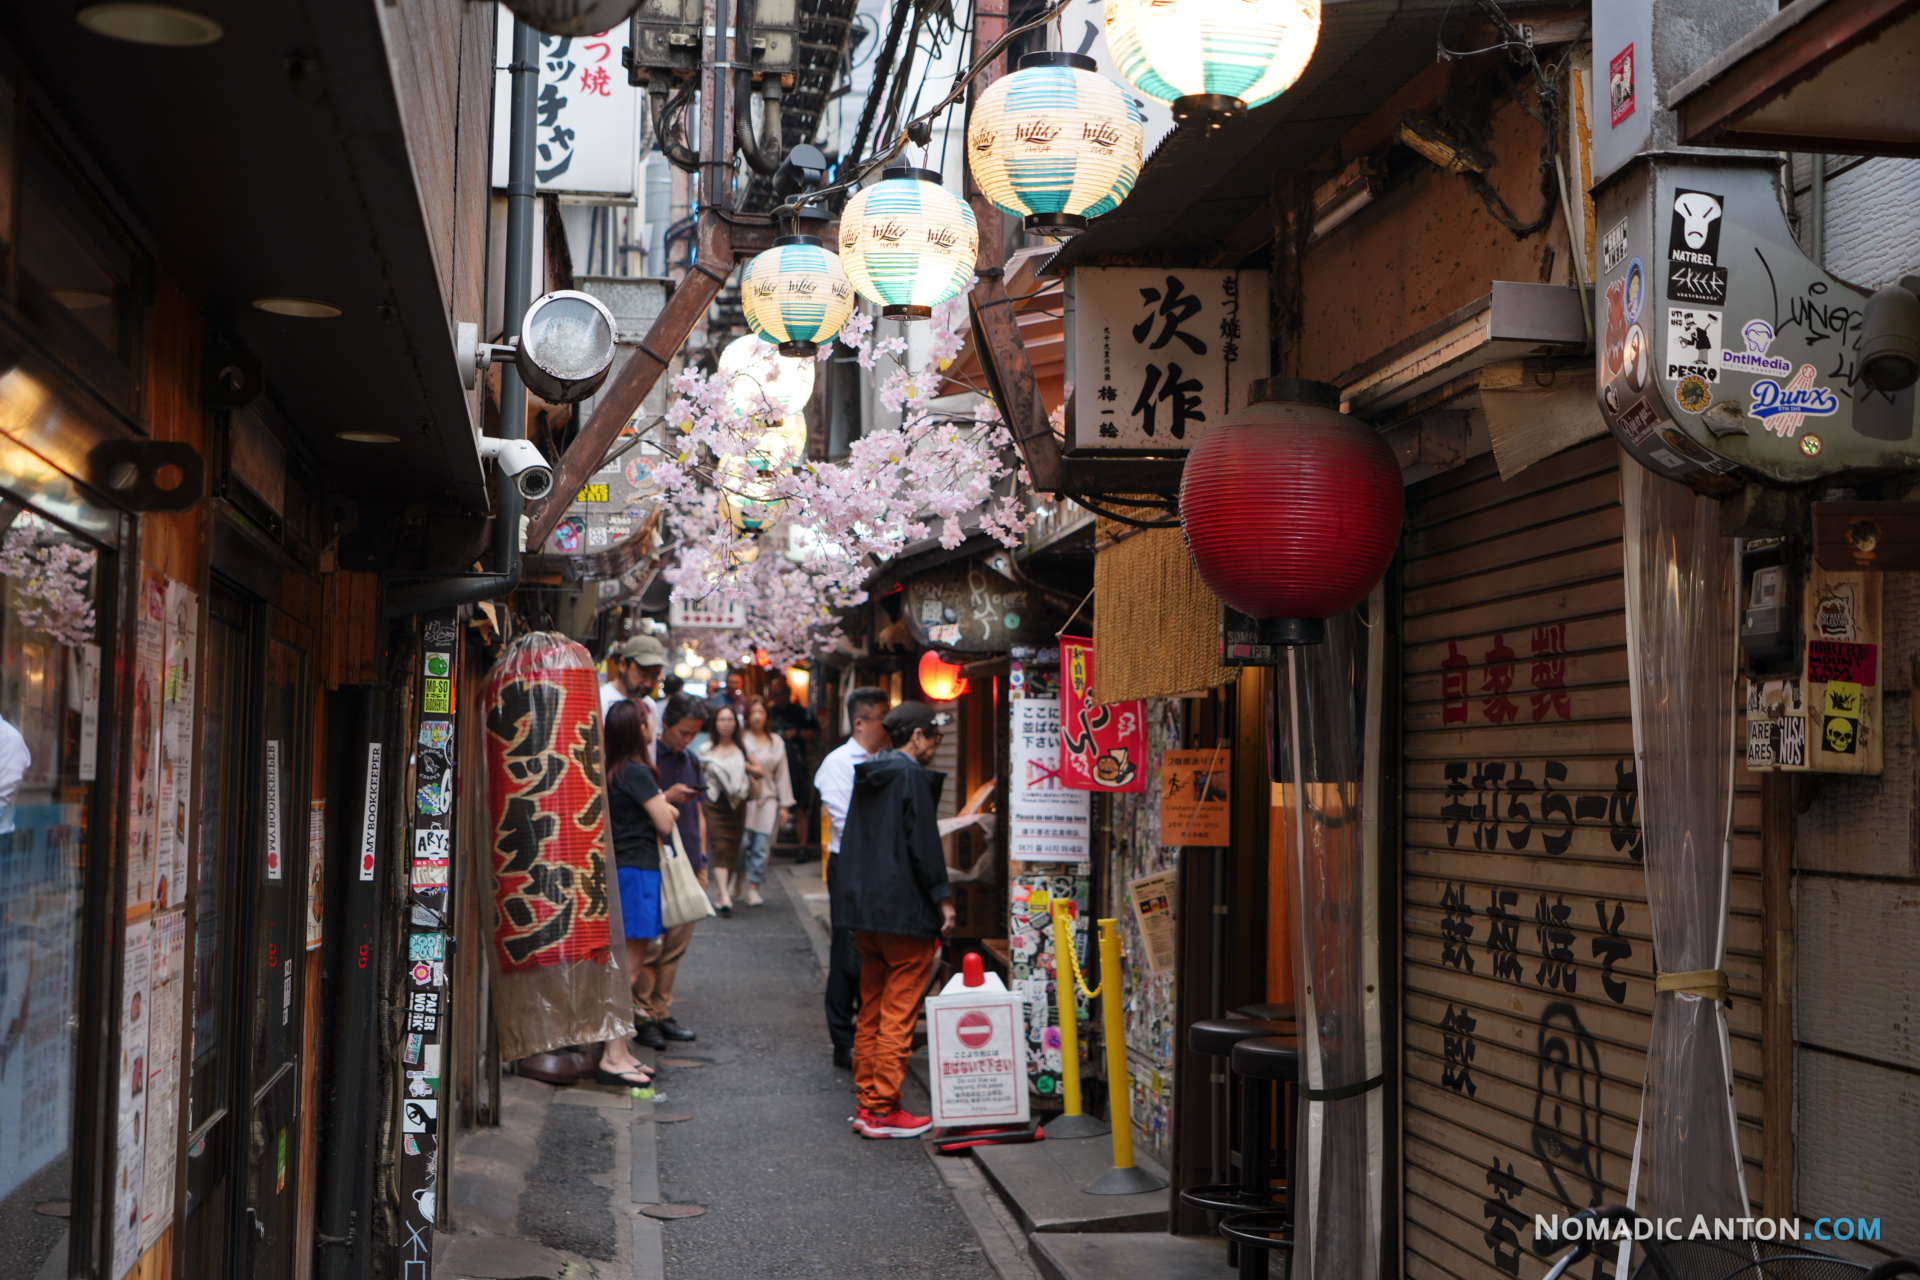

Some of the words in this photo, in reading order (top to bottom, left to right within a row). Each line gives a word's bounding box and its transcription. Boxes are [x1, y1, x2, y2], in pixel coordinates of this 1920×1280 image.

[580, 31, 611, 97] つ焼
[1672, 249, 1714, 267] NATREEL
[1220, 275, 1241, 363] もつ焼き
[1131, 275, 1208, 440] 次作
[1723, 351, 1790, 371] DntlMedia
[1098, 385, 1119, 439] 梅一輪
[1809, 655, 1861, 668] MOUNT
[1441, 623, 1572, 727] 自家製
[1812, 666, 1850, 676] TAM
[1023, 707, 1060, 719] ここに
[421, 722, 432, 731] FCK
[1022, 735, 1060, 748] 下さい
[1748, 743, 1772, 760] ARES
[368, 747, 380, 831] BOOKKEEPER
[367, 833, 375, 852] MY
[942, 1058, 1012, 1076] 並ばないで下さい
